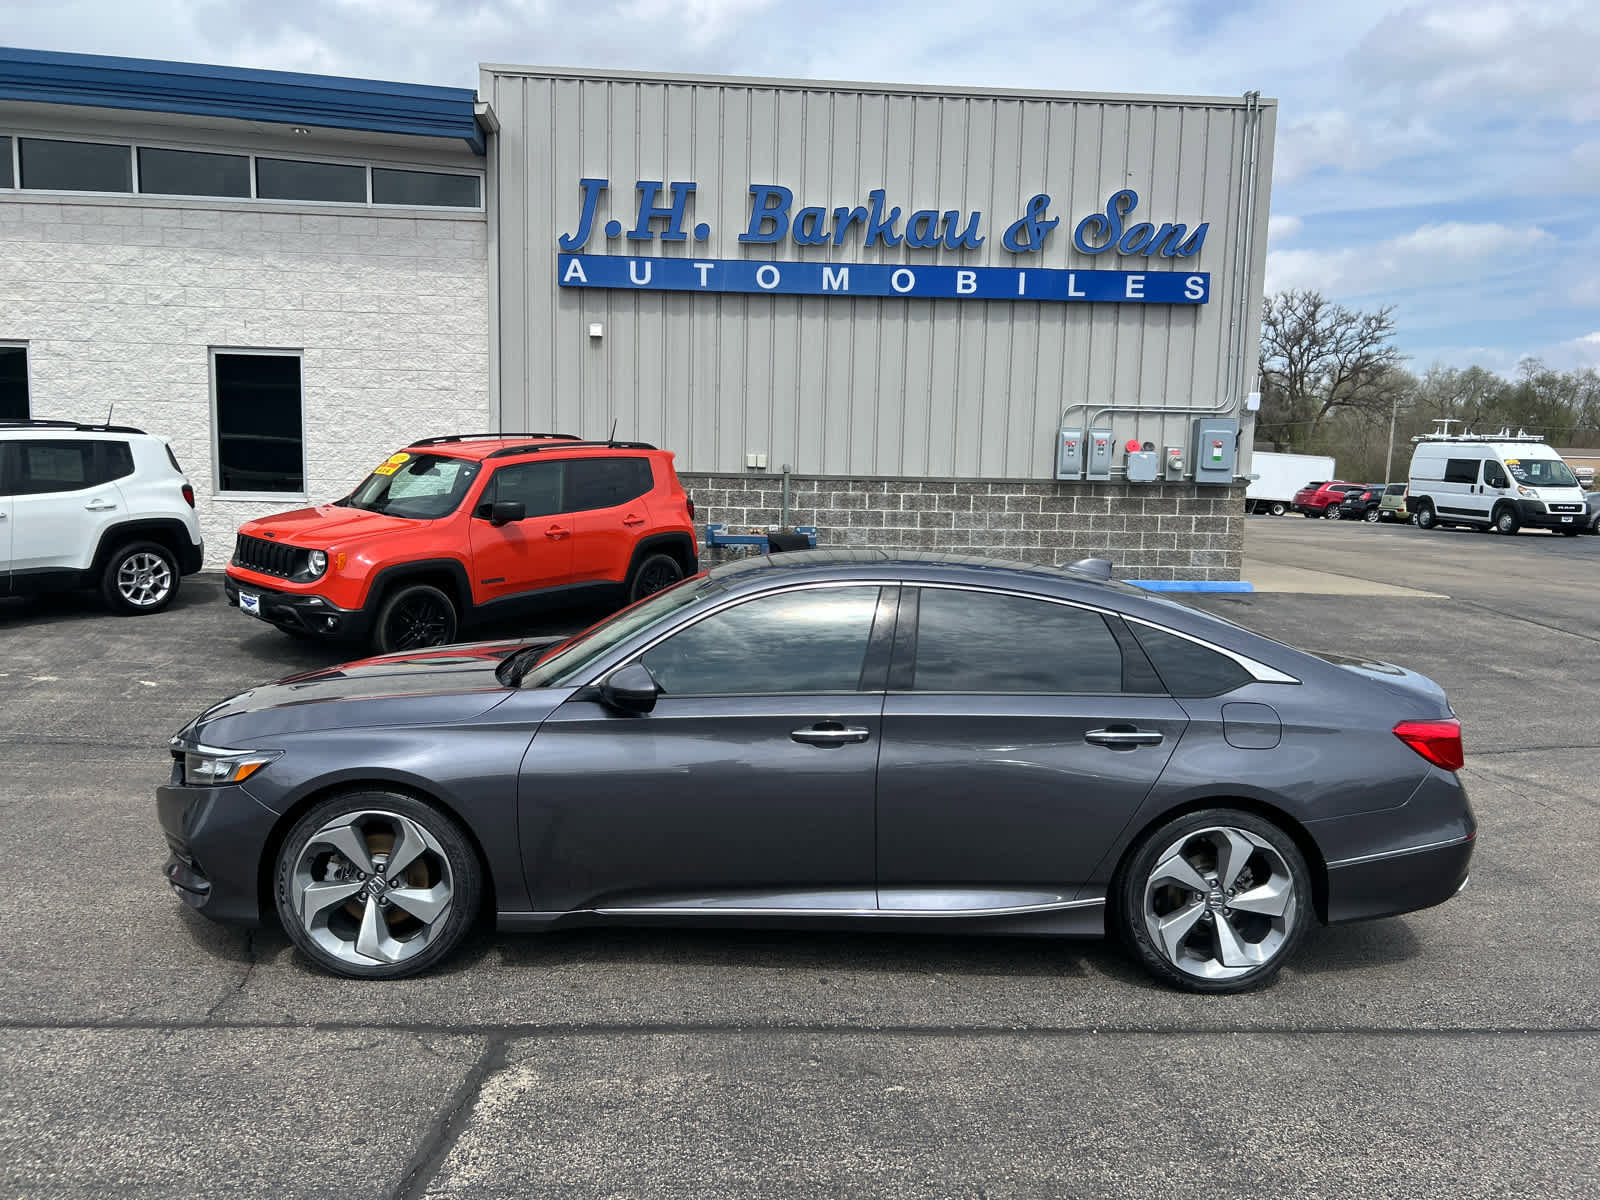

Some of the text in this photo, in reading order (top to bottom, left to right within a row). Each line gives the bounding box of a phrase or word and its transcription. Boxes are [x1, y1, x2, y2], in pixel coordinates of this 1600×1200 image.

[558, 178, 1210, 257] J.H. Barkau & Sons
[563, 257, 1205, 300] AUTOMOBILES
